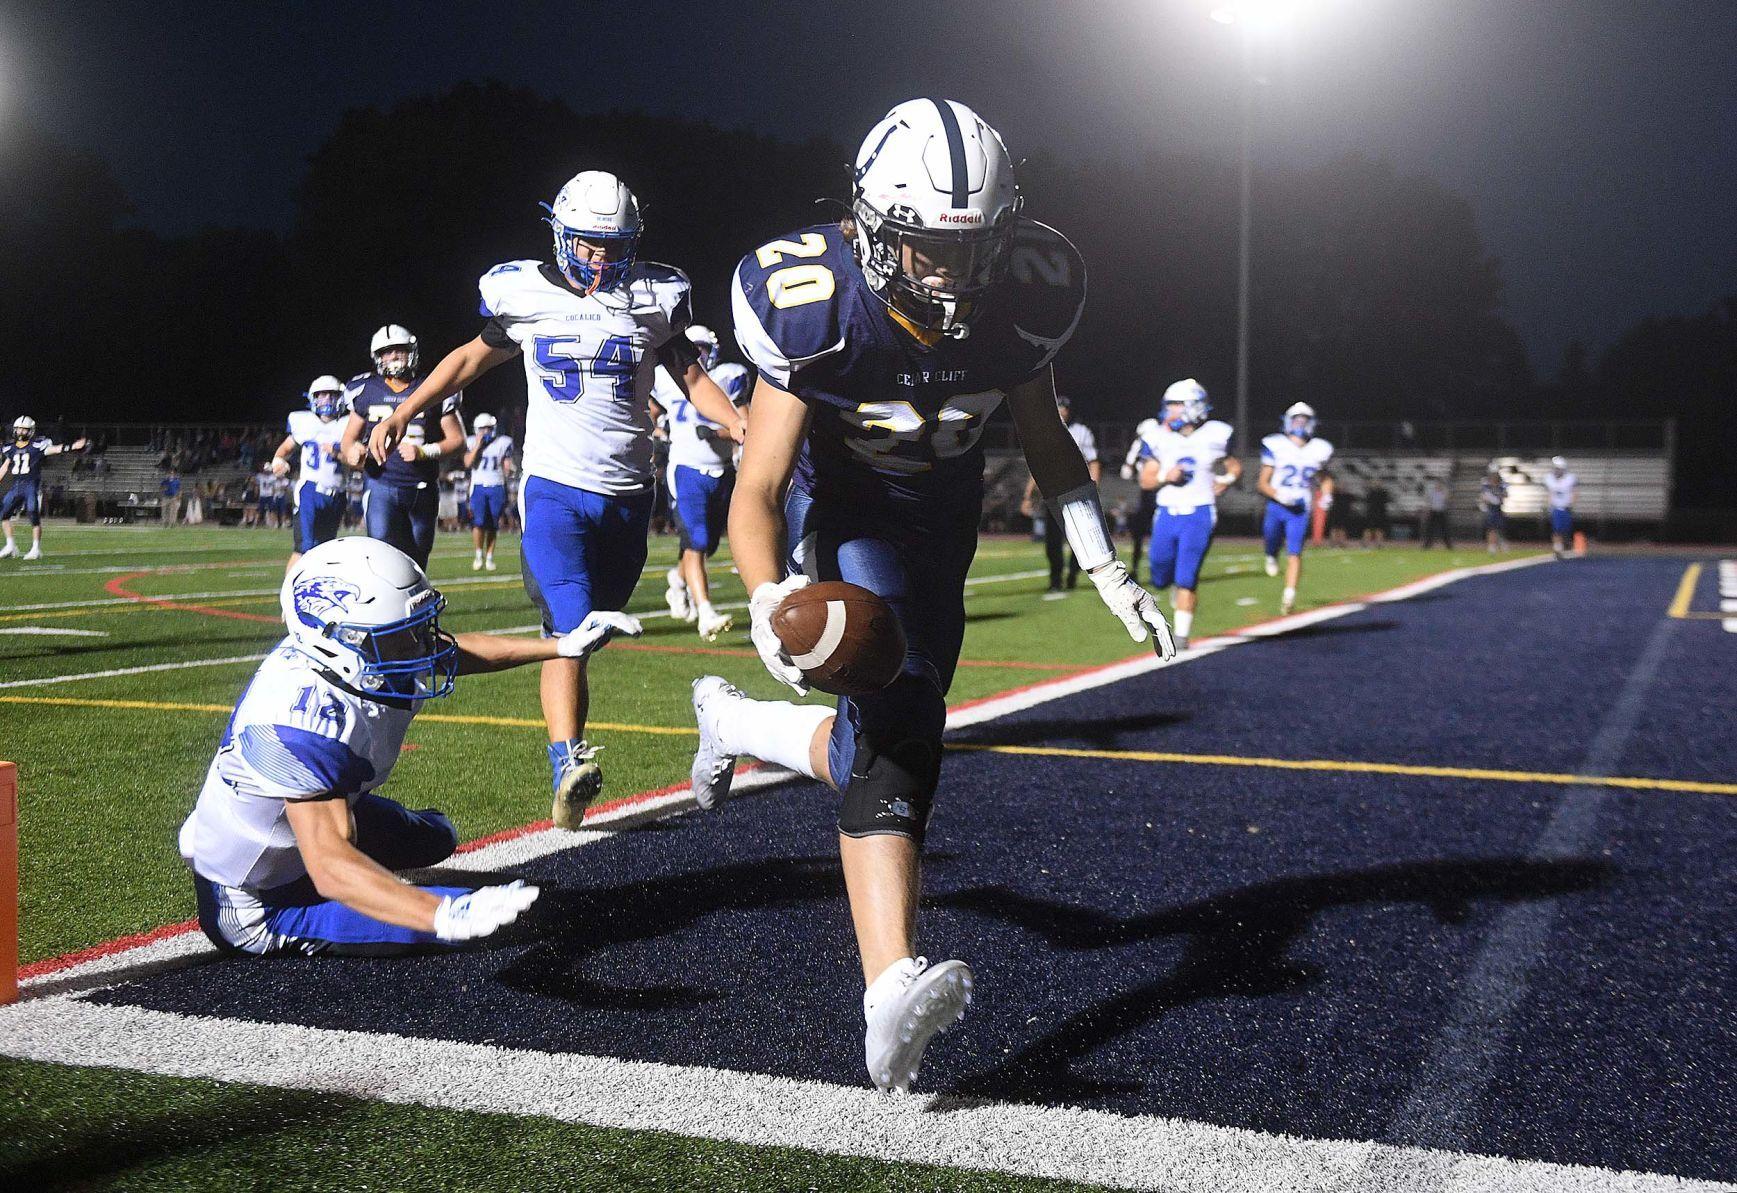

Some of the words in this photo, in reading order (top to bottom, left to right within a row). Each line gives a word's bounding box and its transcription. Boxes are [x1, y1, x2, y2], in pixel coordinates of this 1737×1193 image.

[939, 212, 982, 224] Riddell
[755, 232, 836, 311] 20
[533, 334, 637, 404] 54
[11, 453, 31, 475] 11
